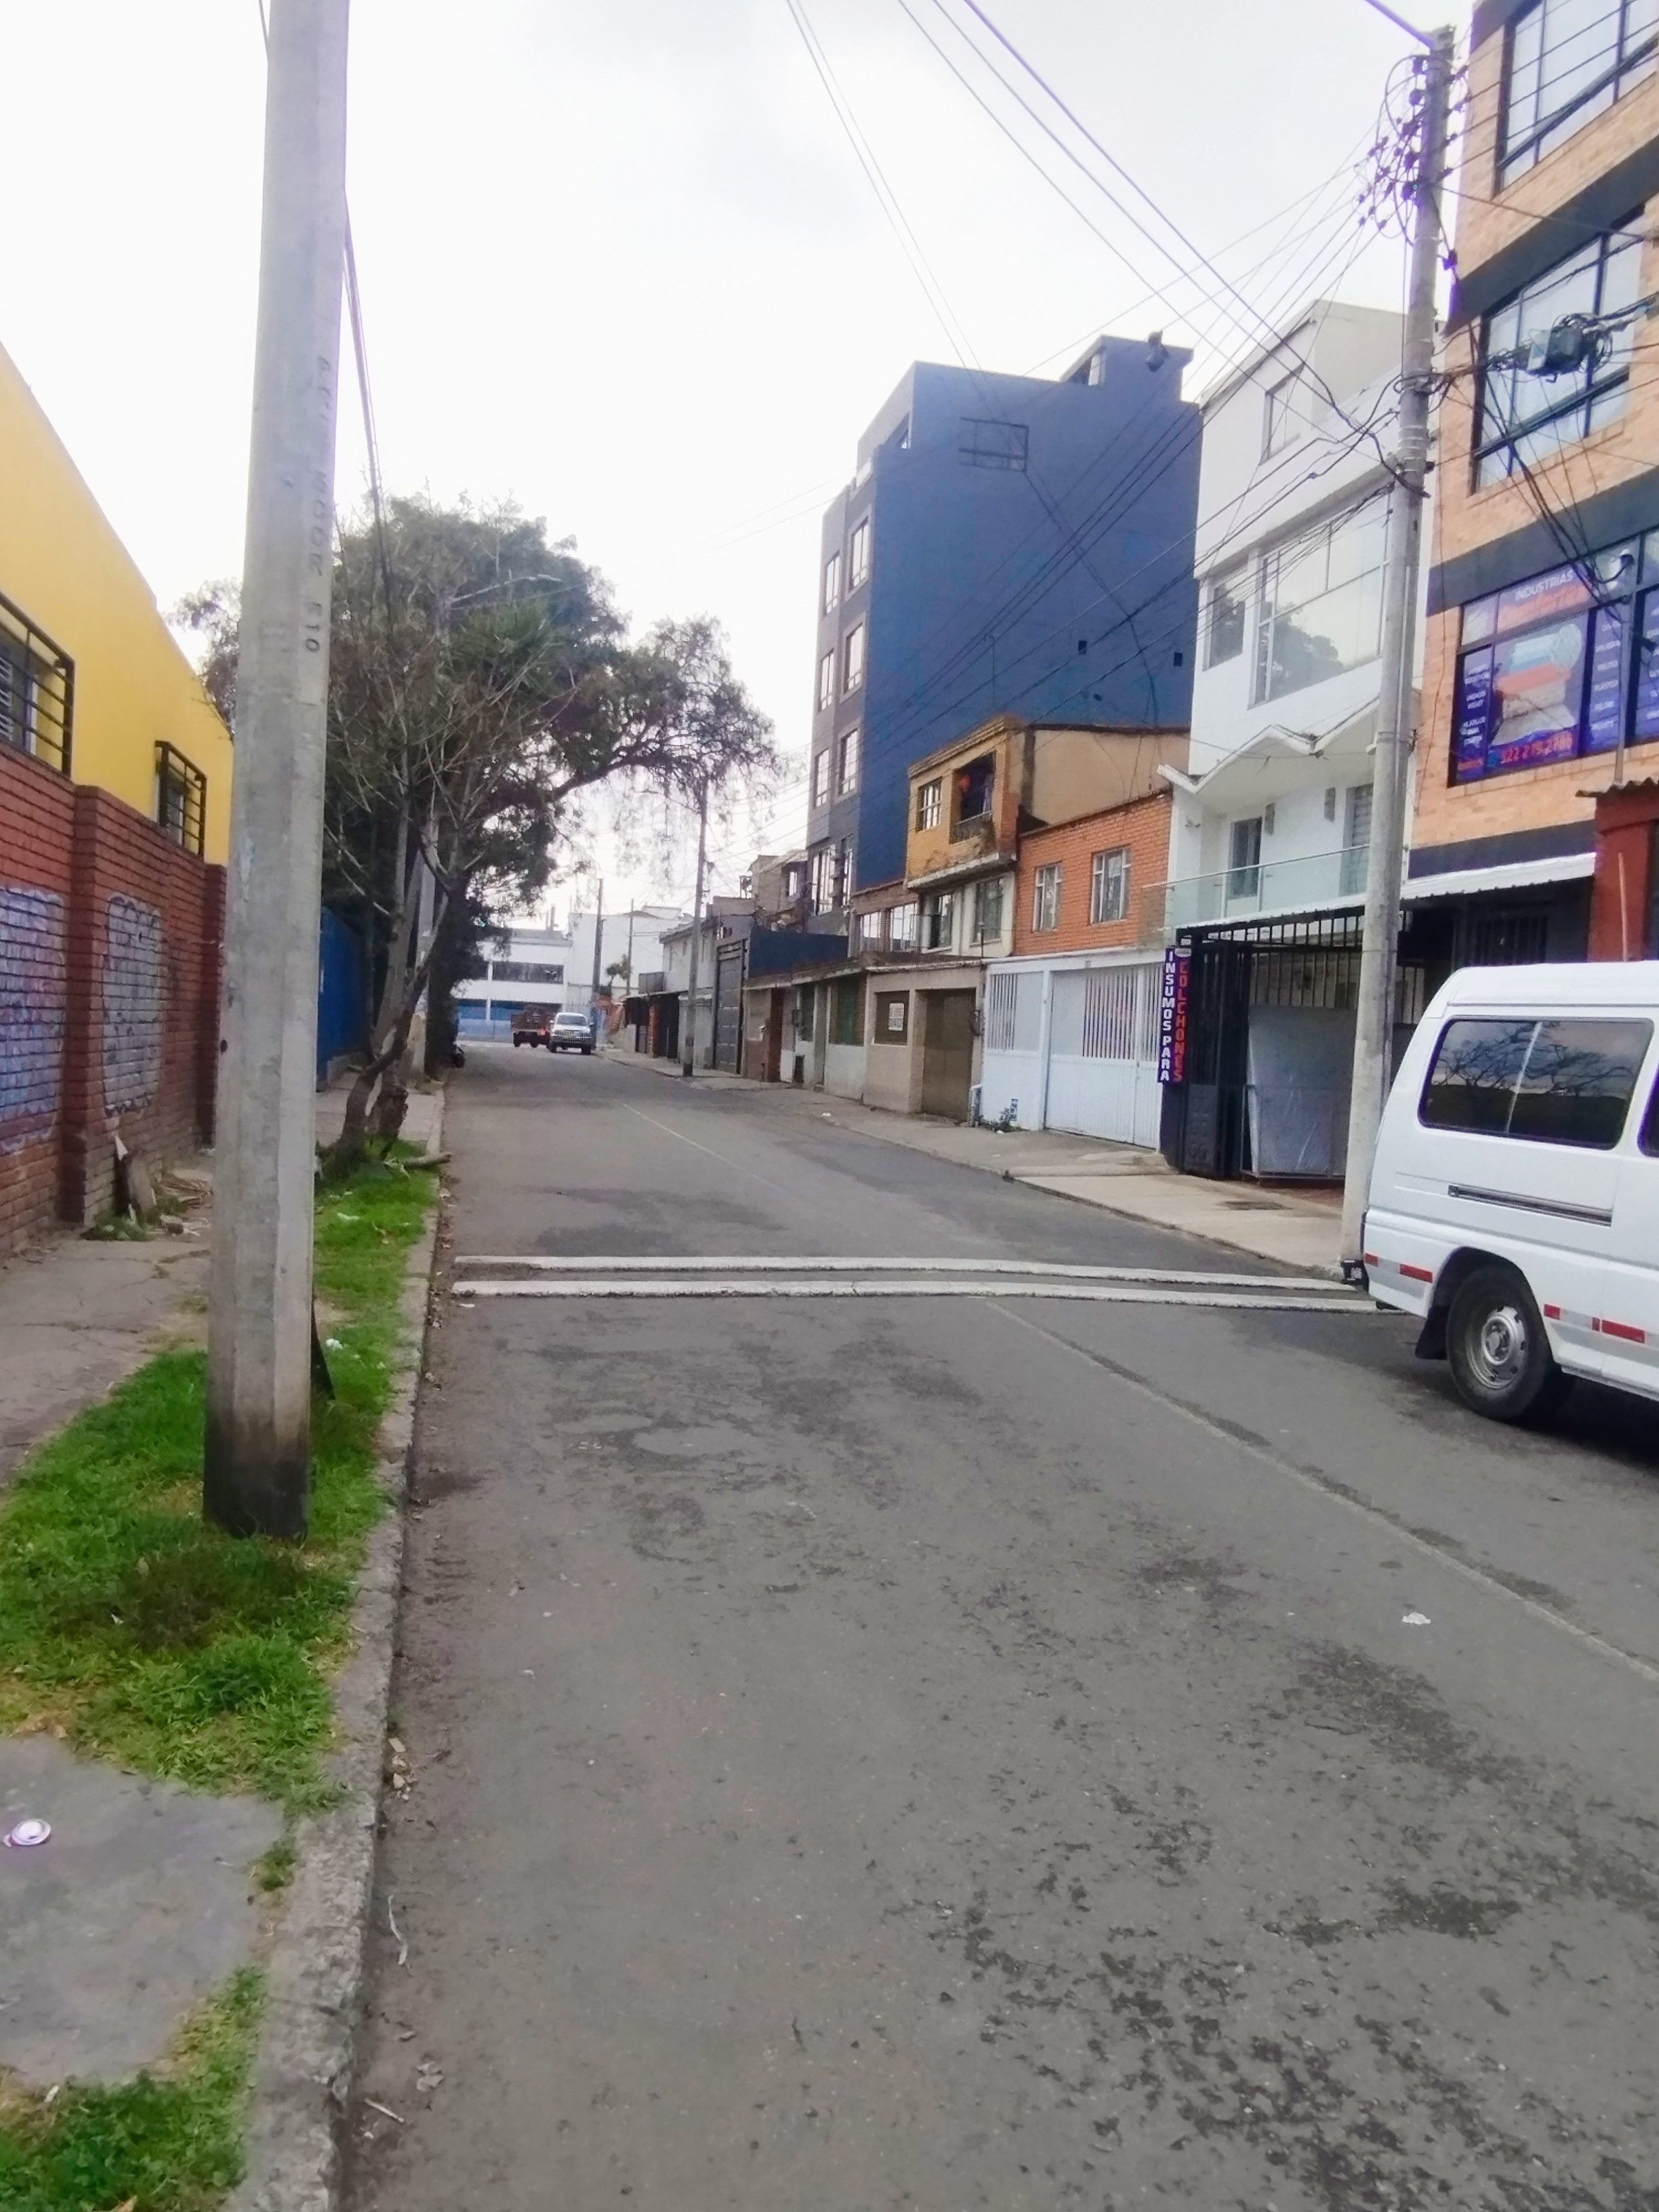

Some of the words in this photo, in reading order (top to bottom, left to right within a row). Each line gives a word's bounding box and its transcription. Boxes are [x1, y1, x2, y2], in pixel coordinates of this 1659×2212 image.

[1516, 570, 1574, 600] INDUSTRIAS
[1162, 951, 1175, 1031] INSUMOS
[1174, 960, 1188, 1082] COLCHONES
[1160, 1036, 1172, 1081] PARA
